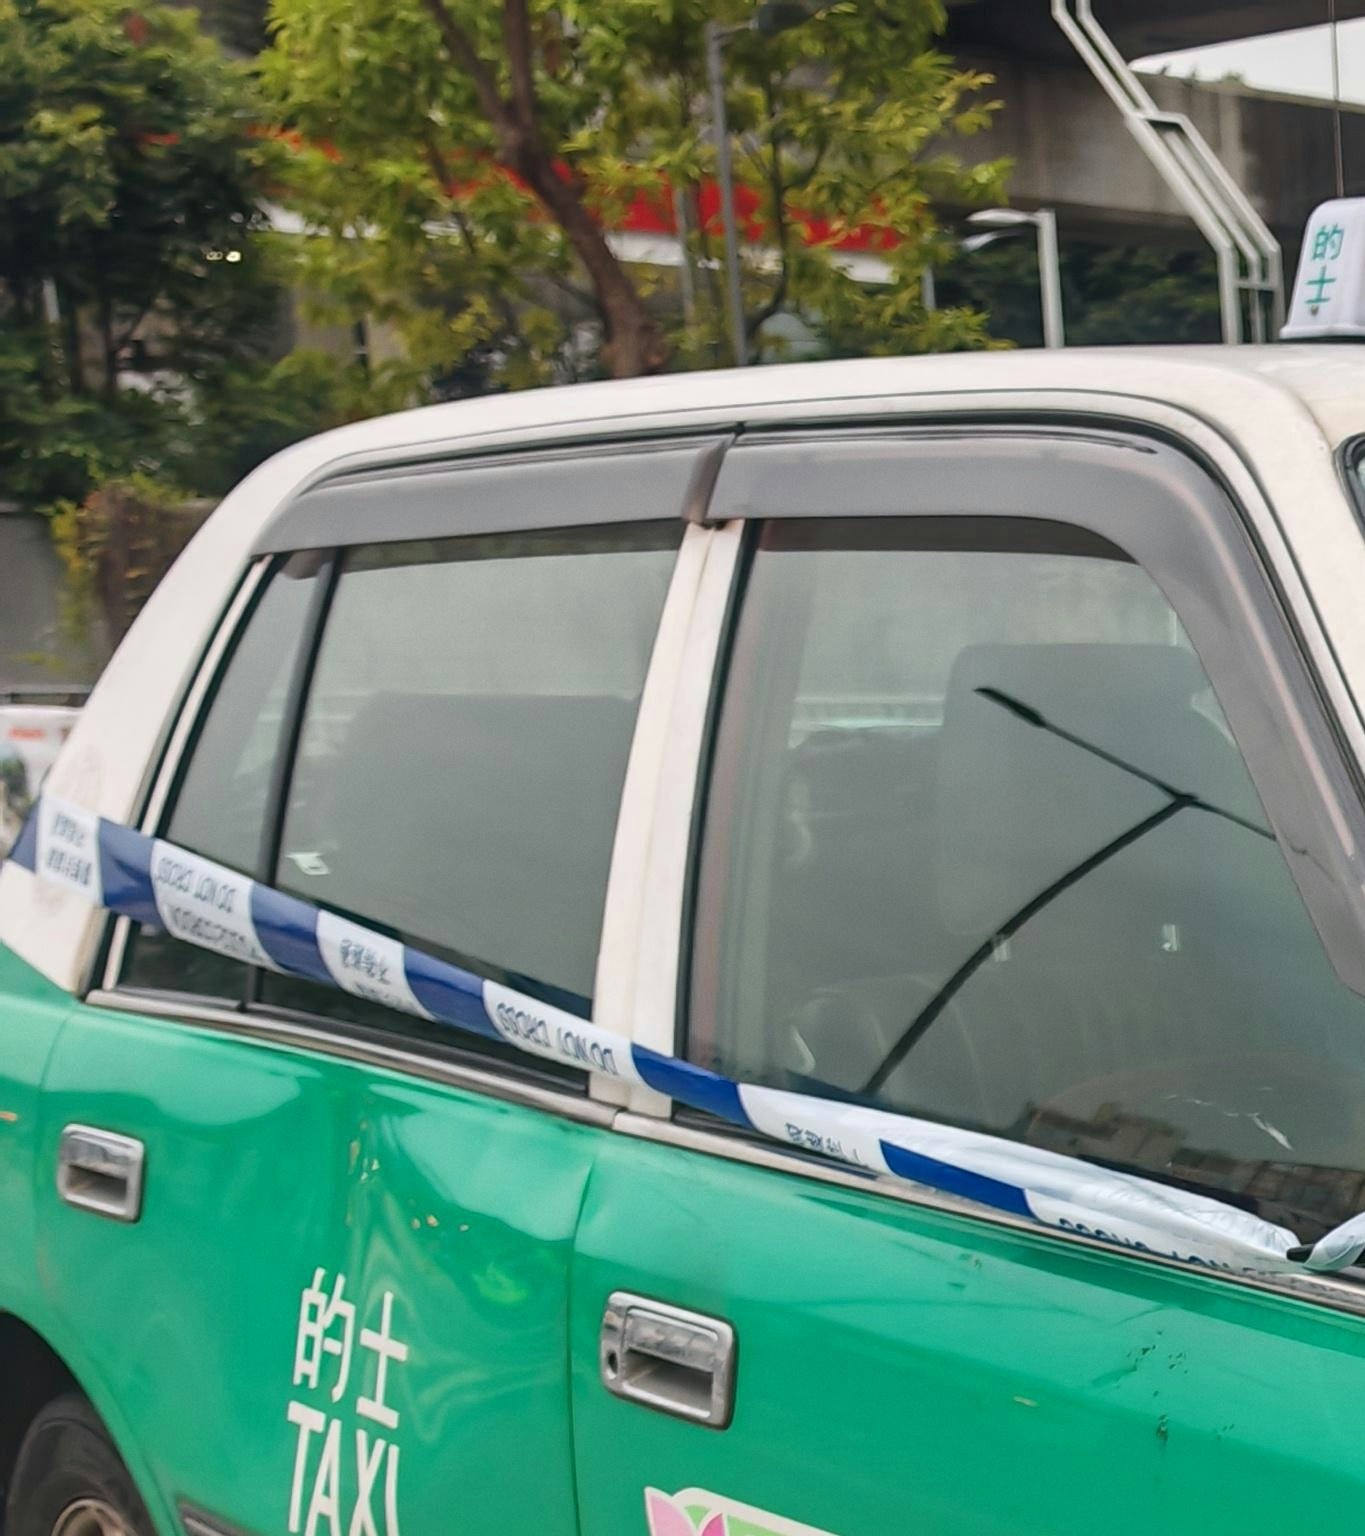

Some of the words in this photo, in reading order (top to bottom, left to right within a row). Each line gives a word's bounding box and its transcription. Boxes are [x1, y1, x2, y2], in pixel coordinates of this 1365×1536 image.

[1305, 223, 1344, 305] 的士
[496, 1001, 551, 1050] CROSS
[292, 1266, 409, 1430] 的士
